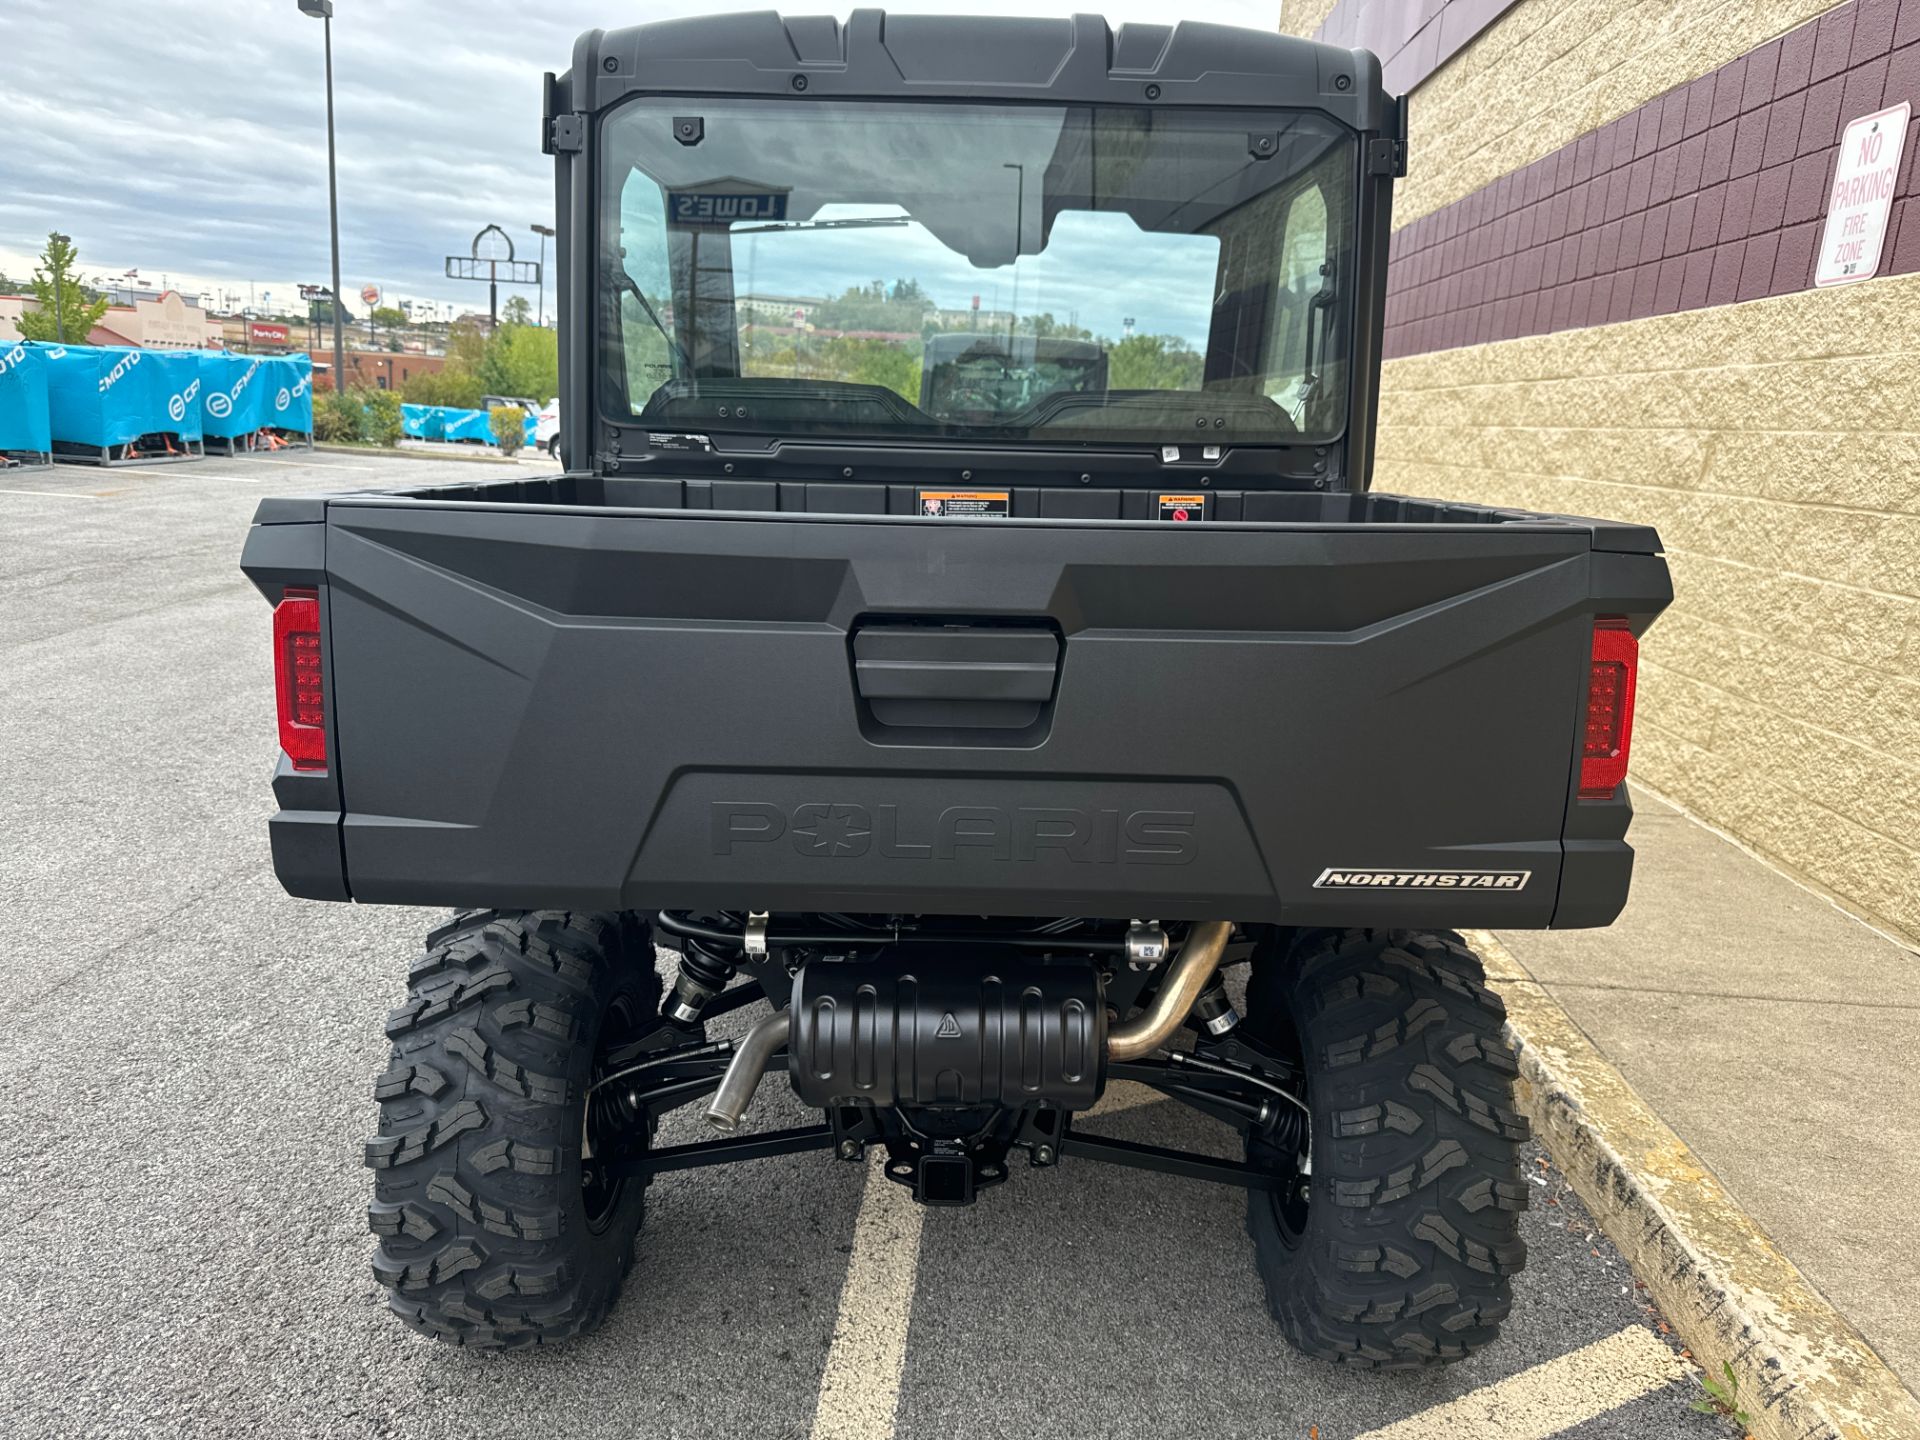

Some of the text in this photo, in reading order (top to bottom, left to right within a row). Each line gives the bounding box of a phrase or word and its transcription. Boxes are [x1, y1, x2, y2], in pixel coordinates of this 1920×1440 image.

[1857, 132, 1883, 168] NO
[1833, 167, 1893, 211] PARKING
[1842, 212, 1868, 237] FIRE
[1834, 239, 1866, 264] ZONE
[253, 329, 286, 340] Party City
[711, 801, 1199, 866] POLARIS
[1326, 873, 1520, 887] NORTHSTAR
